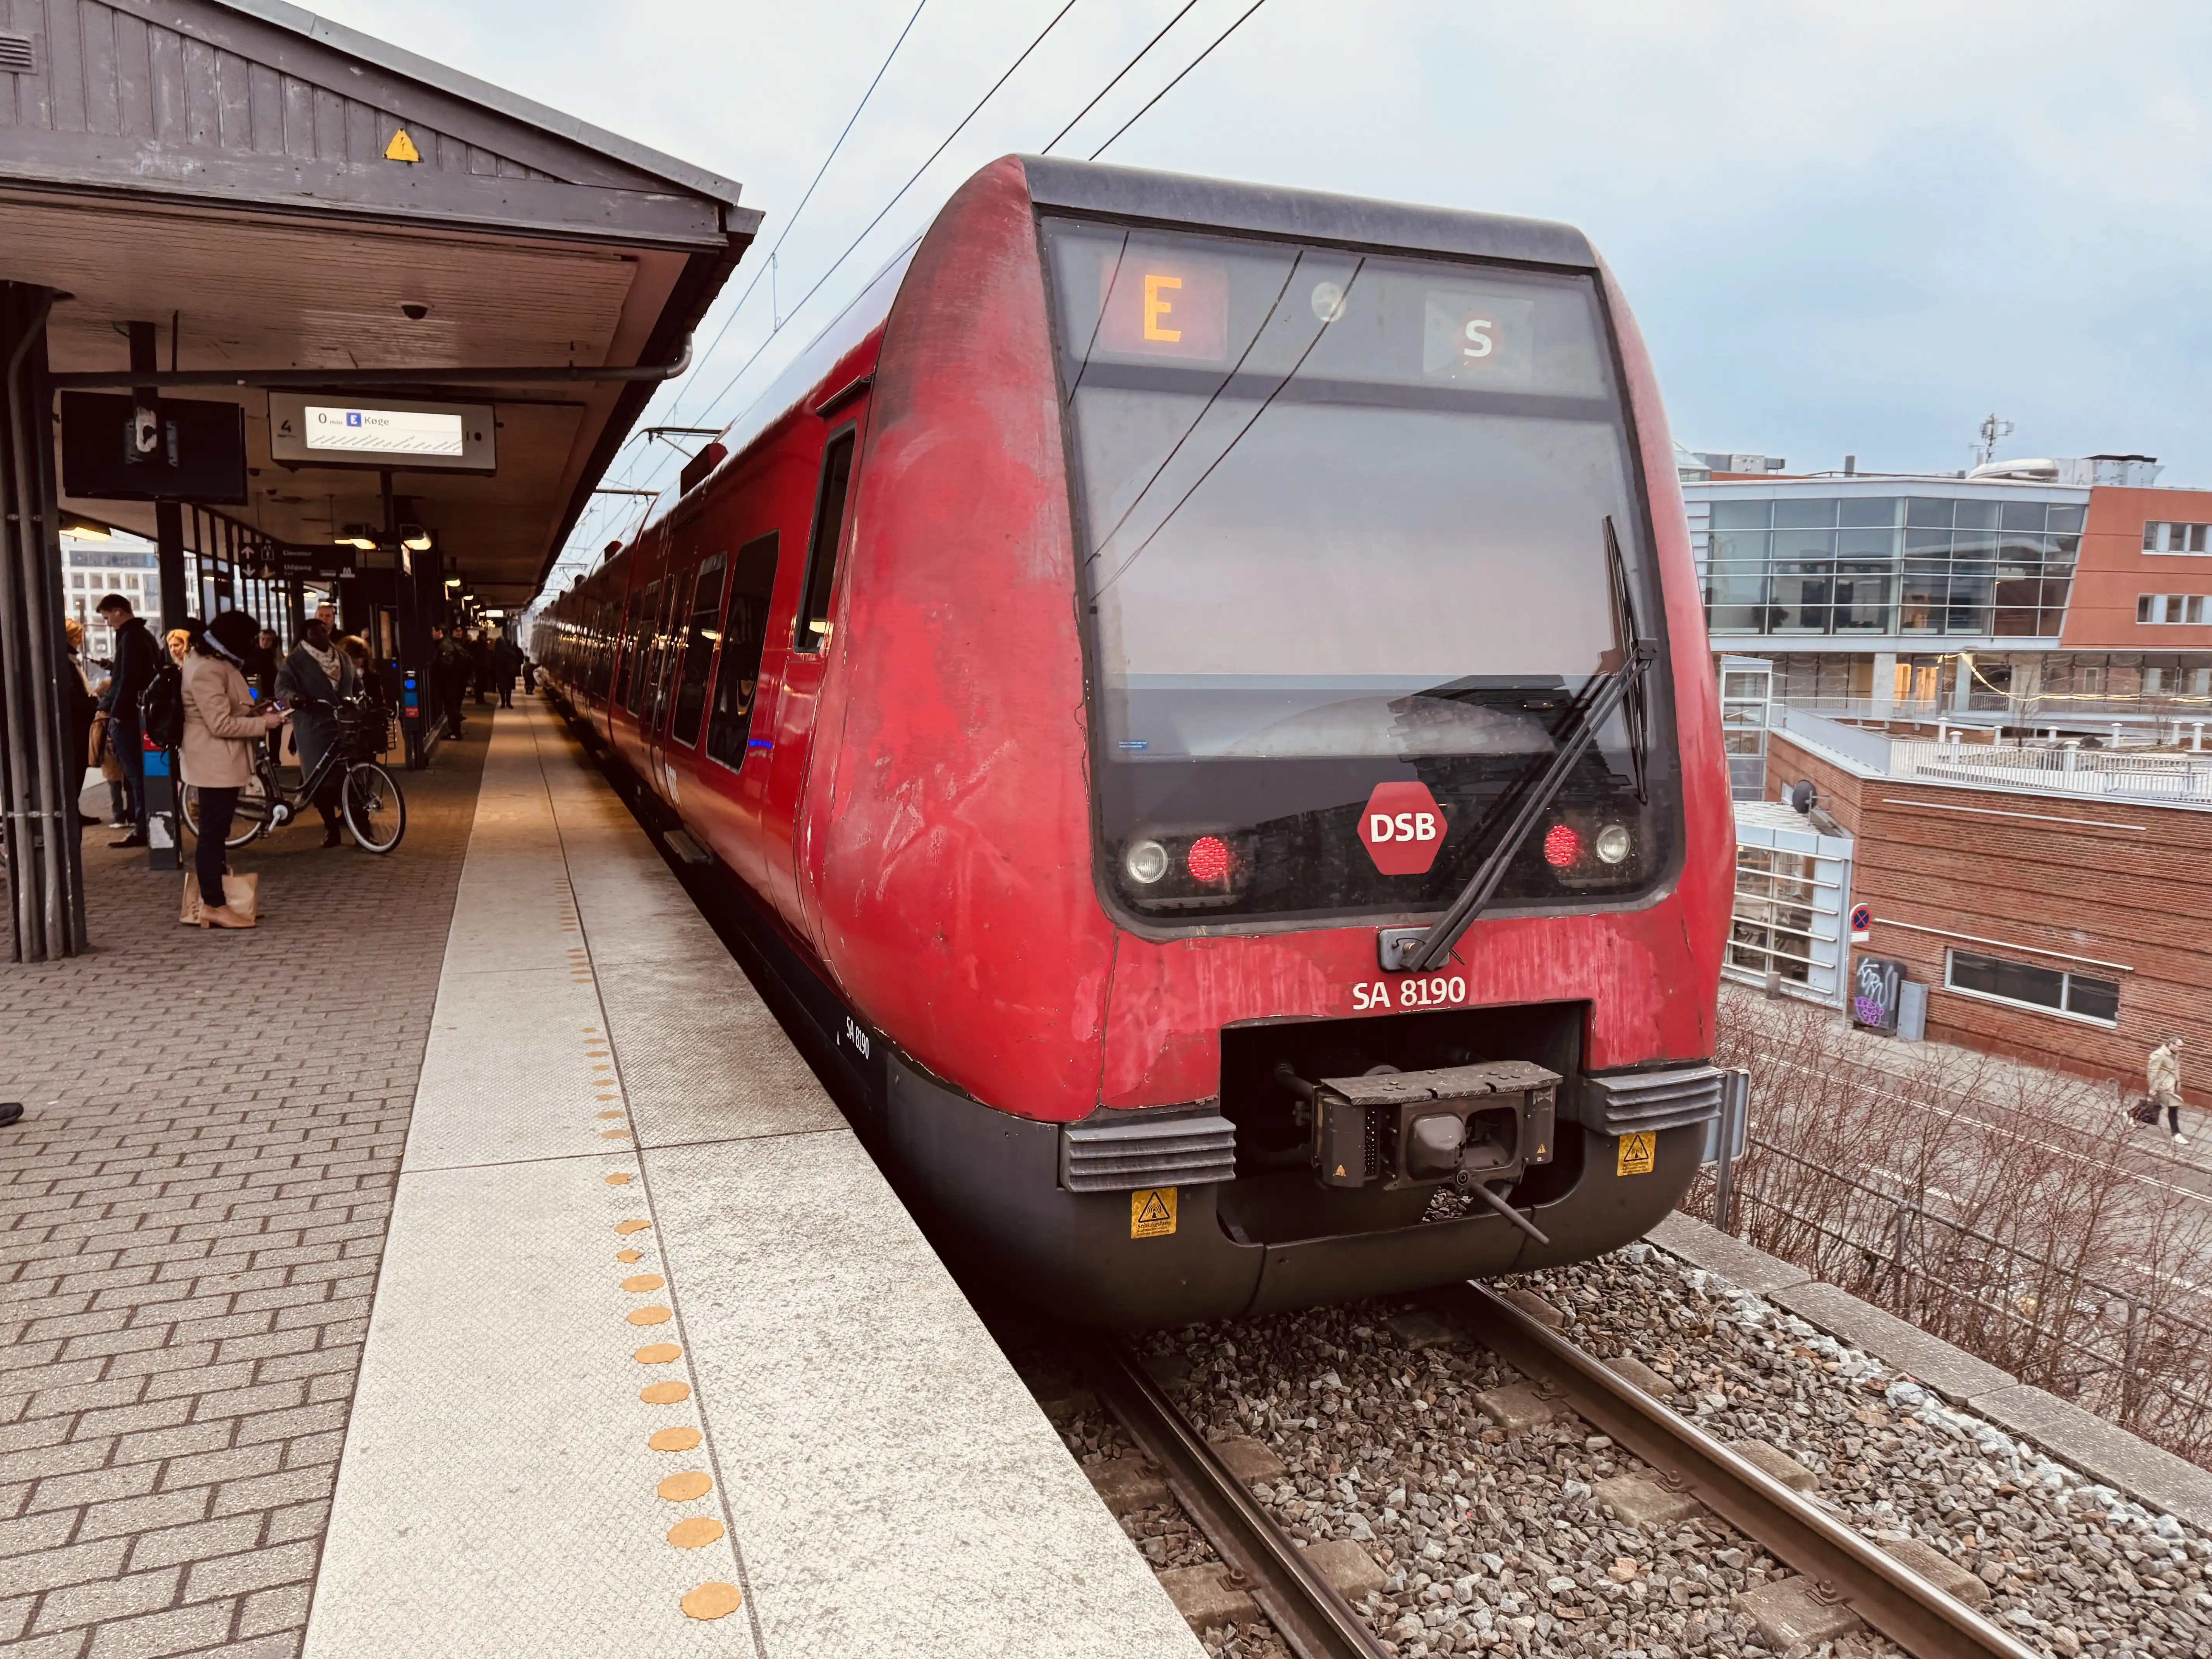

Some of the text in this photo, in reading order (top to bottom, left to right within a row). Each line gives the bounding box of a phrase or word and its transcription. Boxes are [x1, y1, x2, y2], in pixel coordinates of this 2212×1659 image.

[1144, 275, 1182, 342] E
[1464, 319, 1492, 357] S
[281, 419, 291, 432] 4
[318, 413, 327, 424] 0
[350, 415, 357, 424] E
[365, 417, 389, 426] Køge
[1370, 813, 1436, 842] DSB
[1353, 976, 1466, 1010] SA 8190
[847, 1016, 869, 1060] SA 8190
